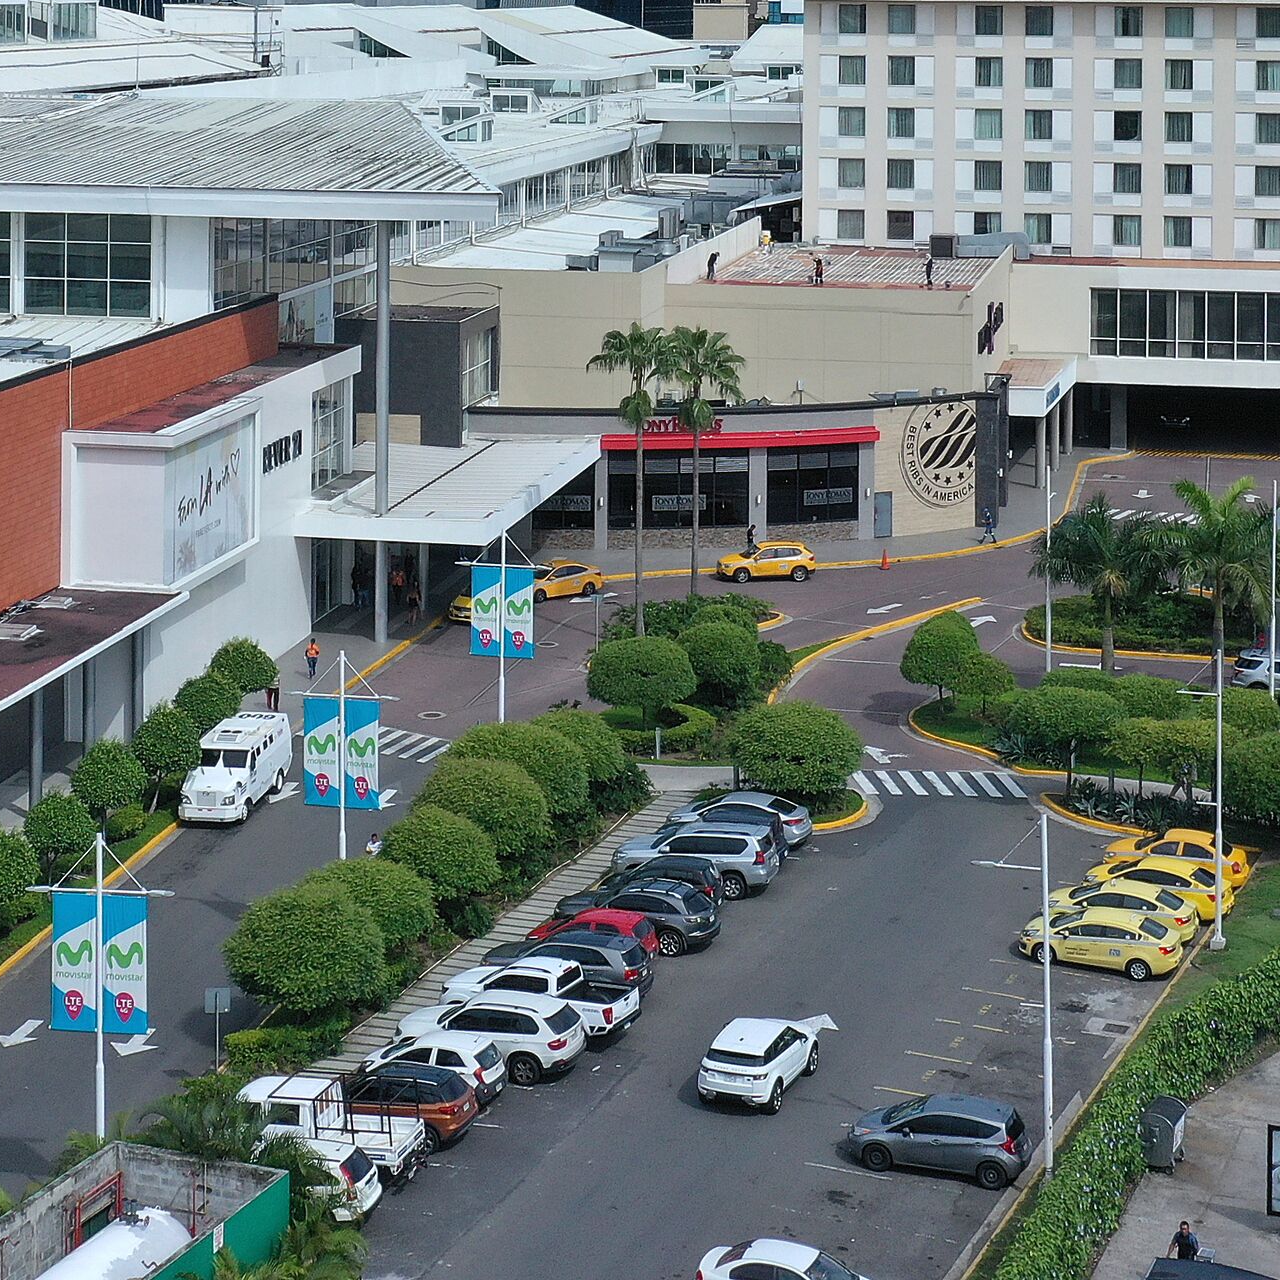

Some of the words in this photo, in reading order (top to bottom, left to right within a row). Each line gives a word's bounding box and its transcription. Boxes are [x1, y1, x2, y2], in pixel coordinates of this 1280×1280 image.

[906, 425, 917, 457] BEST
[907, 459, 924, 486] RIBS
[922, 484, 933, 496] IN
[932, 483, 974, 501] AMERICA
[315, 778, 328, 786] LTE
[354, 781, 367, 789] LTE
[56, 970, 93, 980] movistar
[106, 972, 144, 982] movistar
[65, 996, 82, 1006] LTE
[116, 998, 133, 1009] LTE
